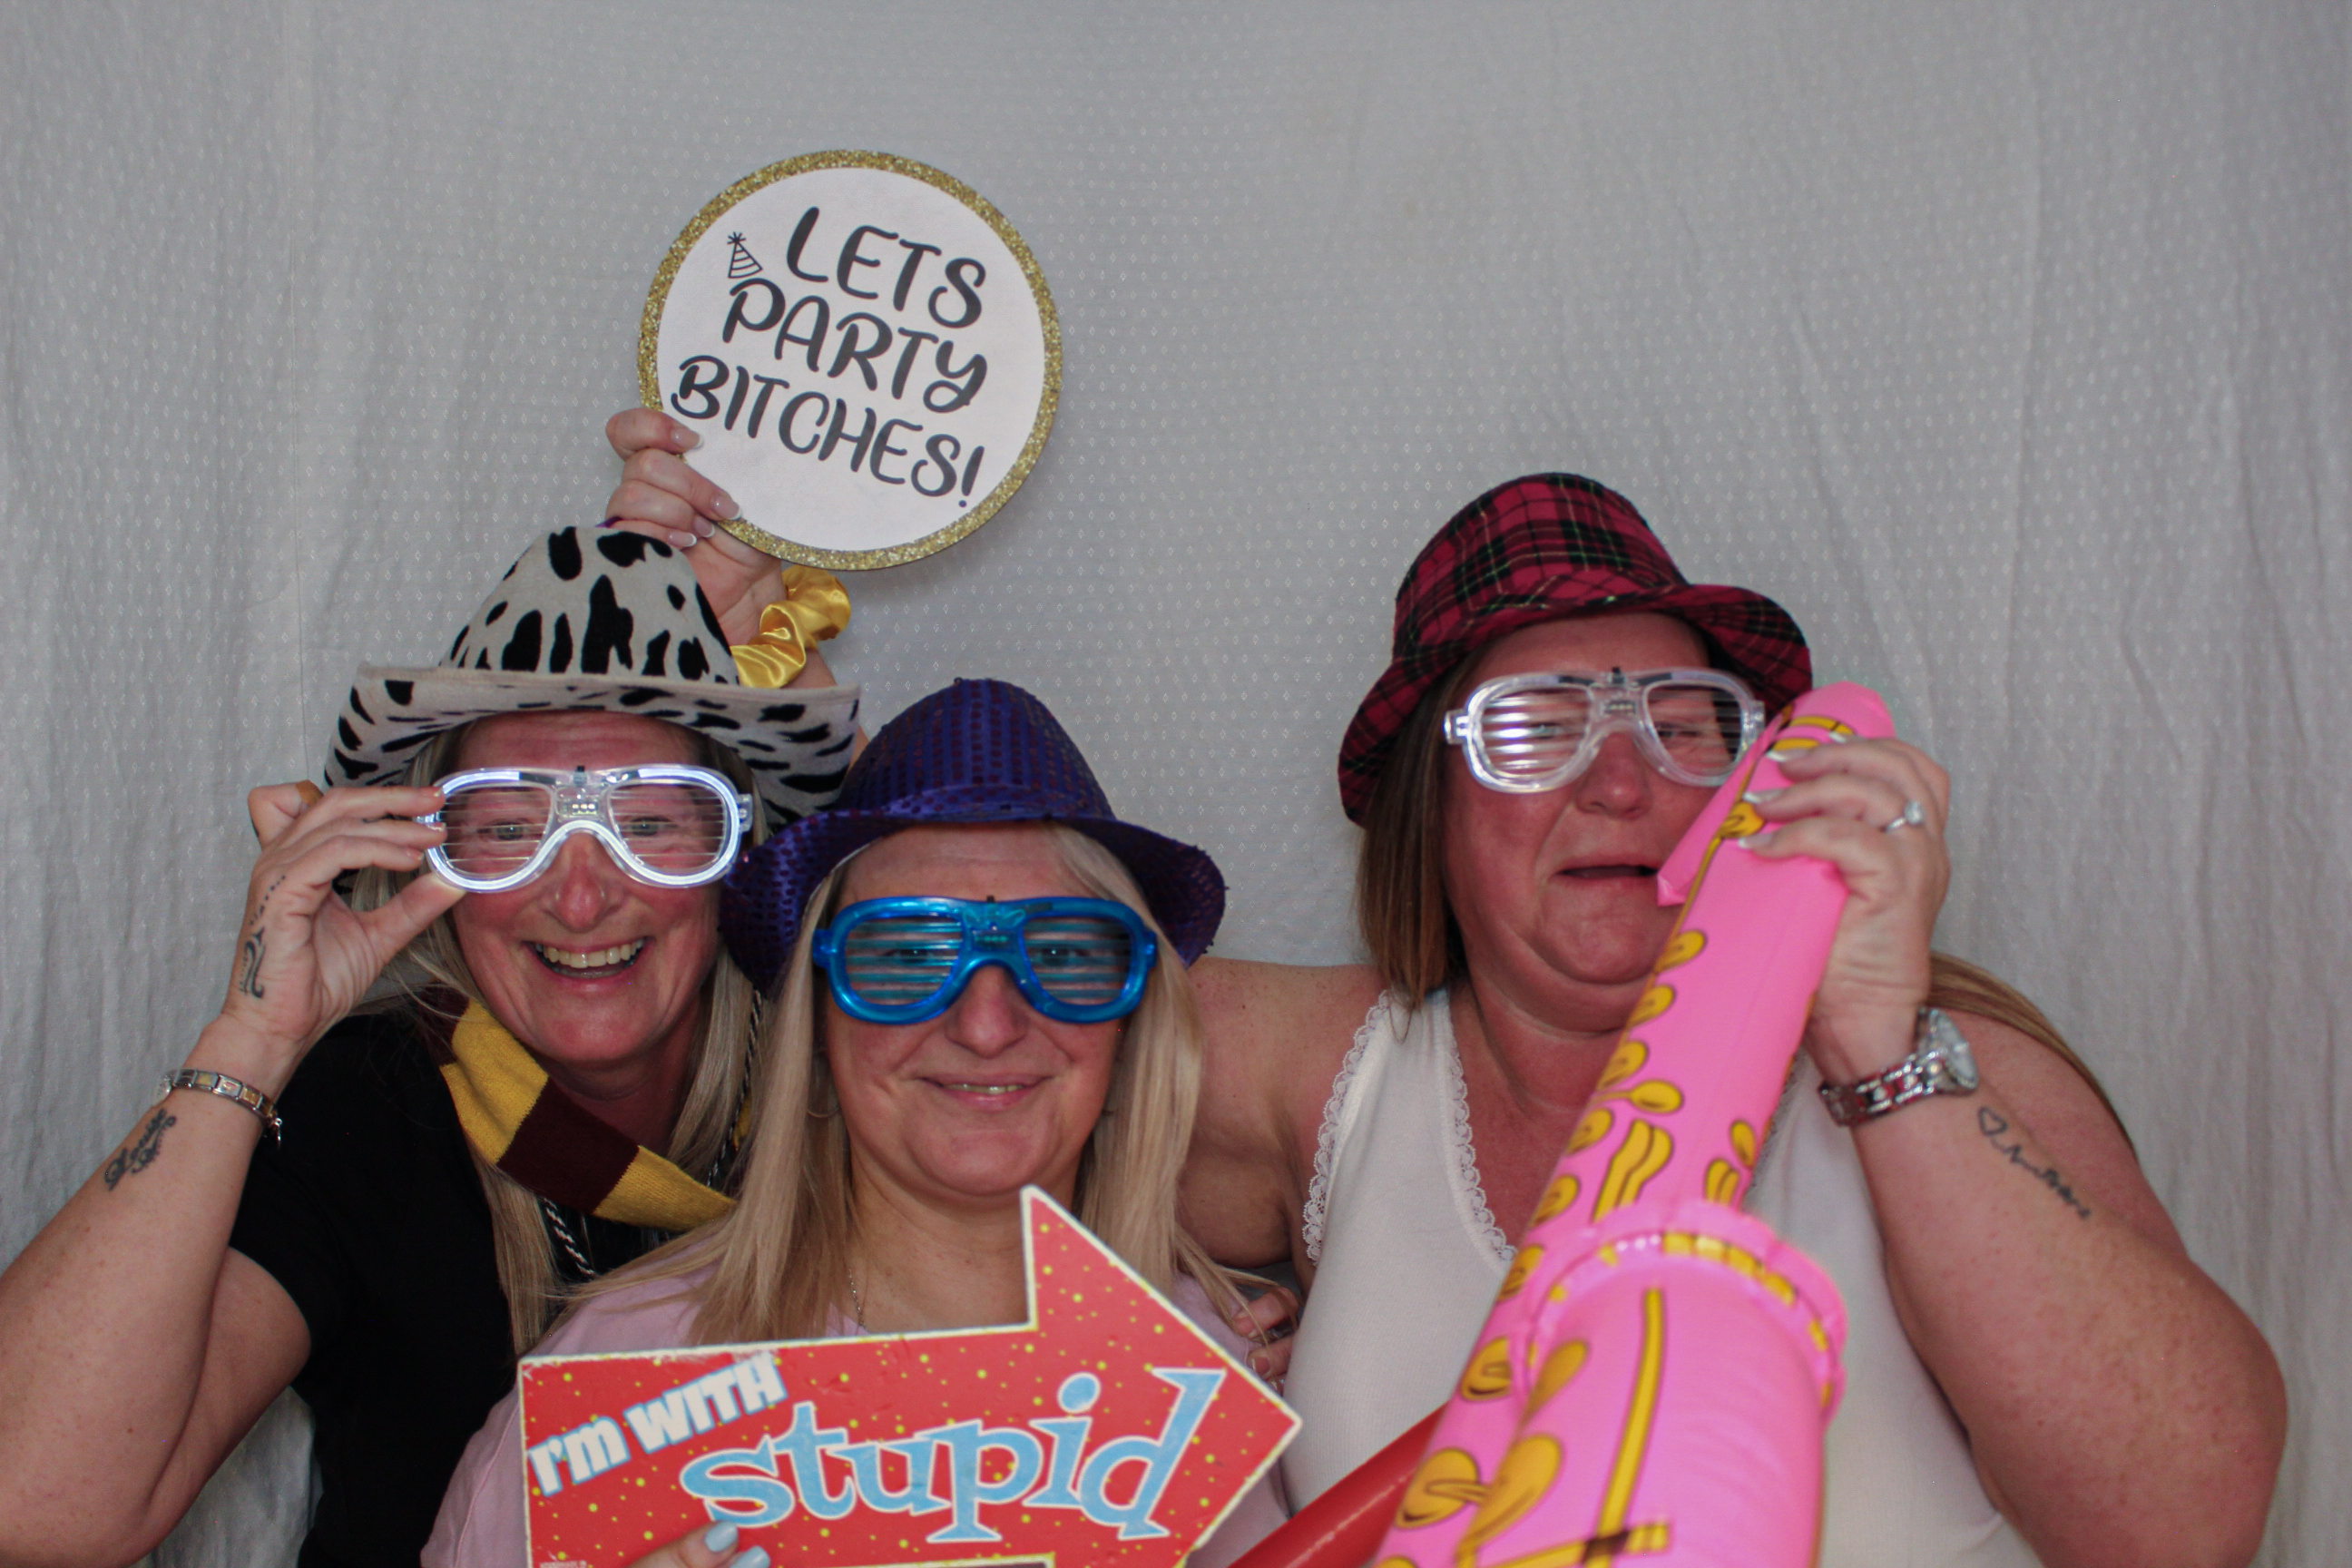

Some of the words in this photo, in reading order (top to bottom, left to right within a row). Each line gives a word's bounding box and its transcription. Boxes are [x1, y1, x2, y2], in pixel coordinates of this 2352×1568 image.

[786, 206, 986, 328] LETS
[722, 278, 988, 414] PARTY
[671, 355, 985, 508] BITCHES!
[622, 1351, 789, 1455] WITH
[680, 1368, 1227, 1544] stupid
